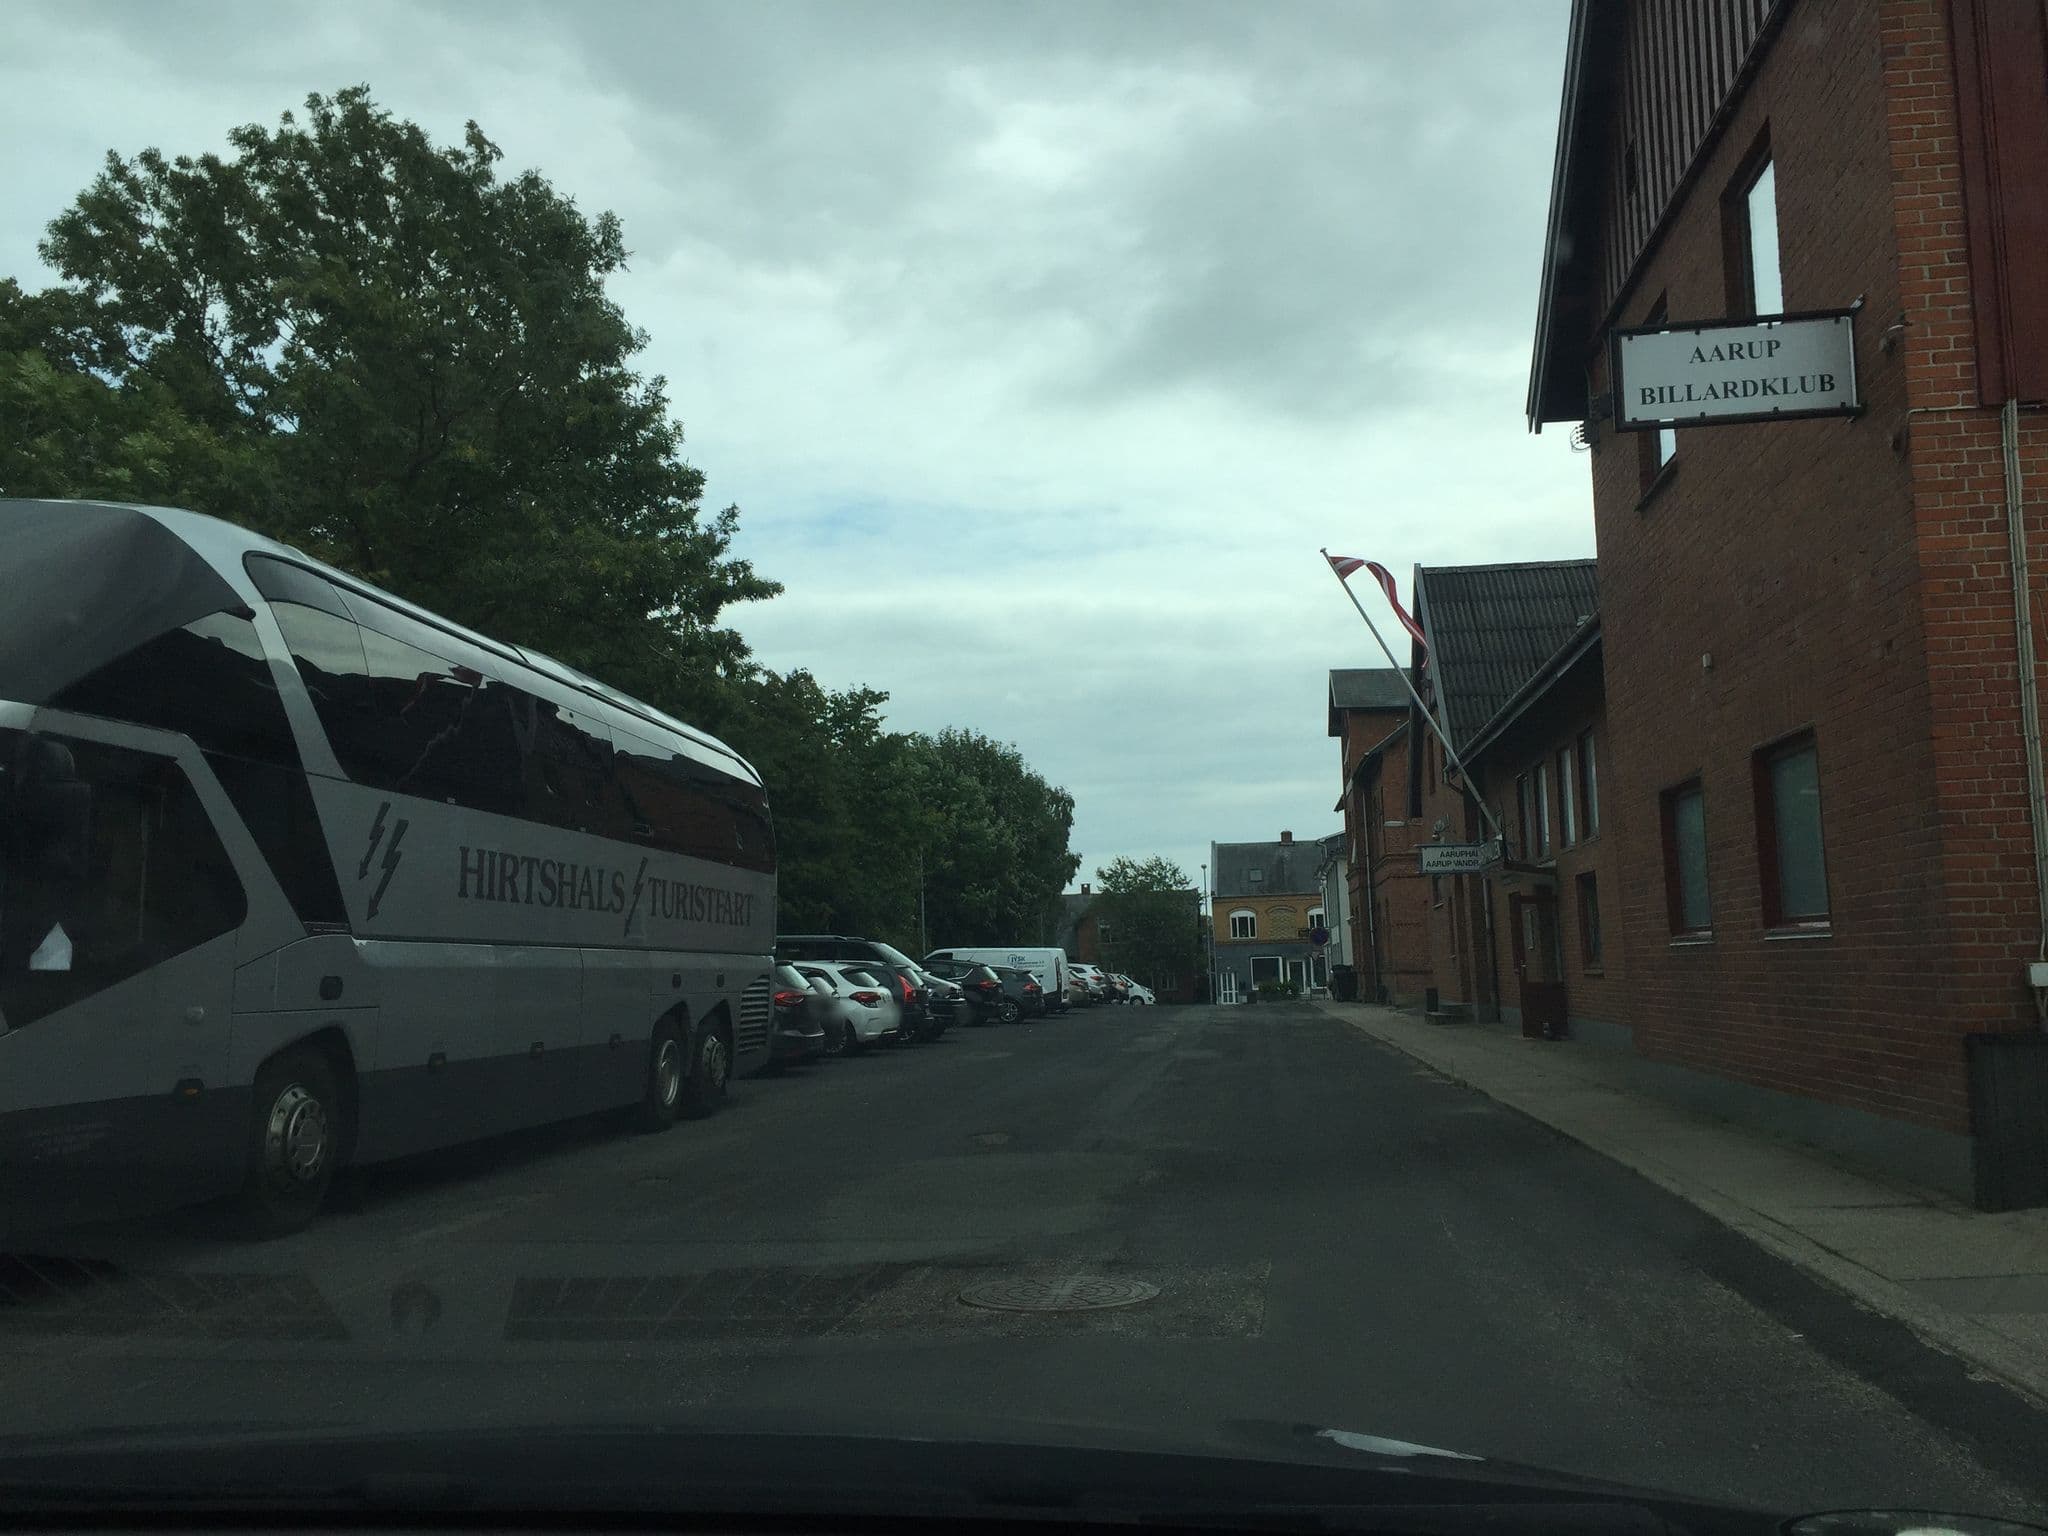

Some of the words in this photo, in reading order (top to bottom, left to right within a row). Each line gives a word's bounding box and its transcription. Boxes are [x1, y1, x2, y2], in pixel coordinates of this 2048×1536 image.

[1689, 339, 1781, 364] AARUP
[1639, 373, 1836, 406] BILLARDKLUB
[457, 845, 626, 914] HIRTSHALS
[647, 876, 755, 927] TURISTFART
